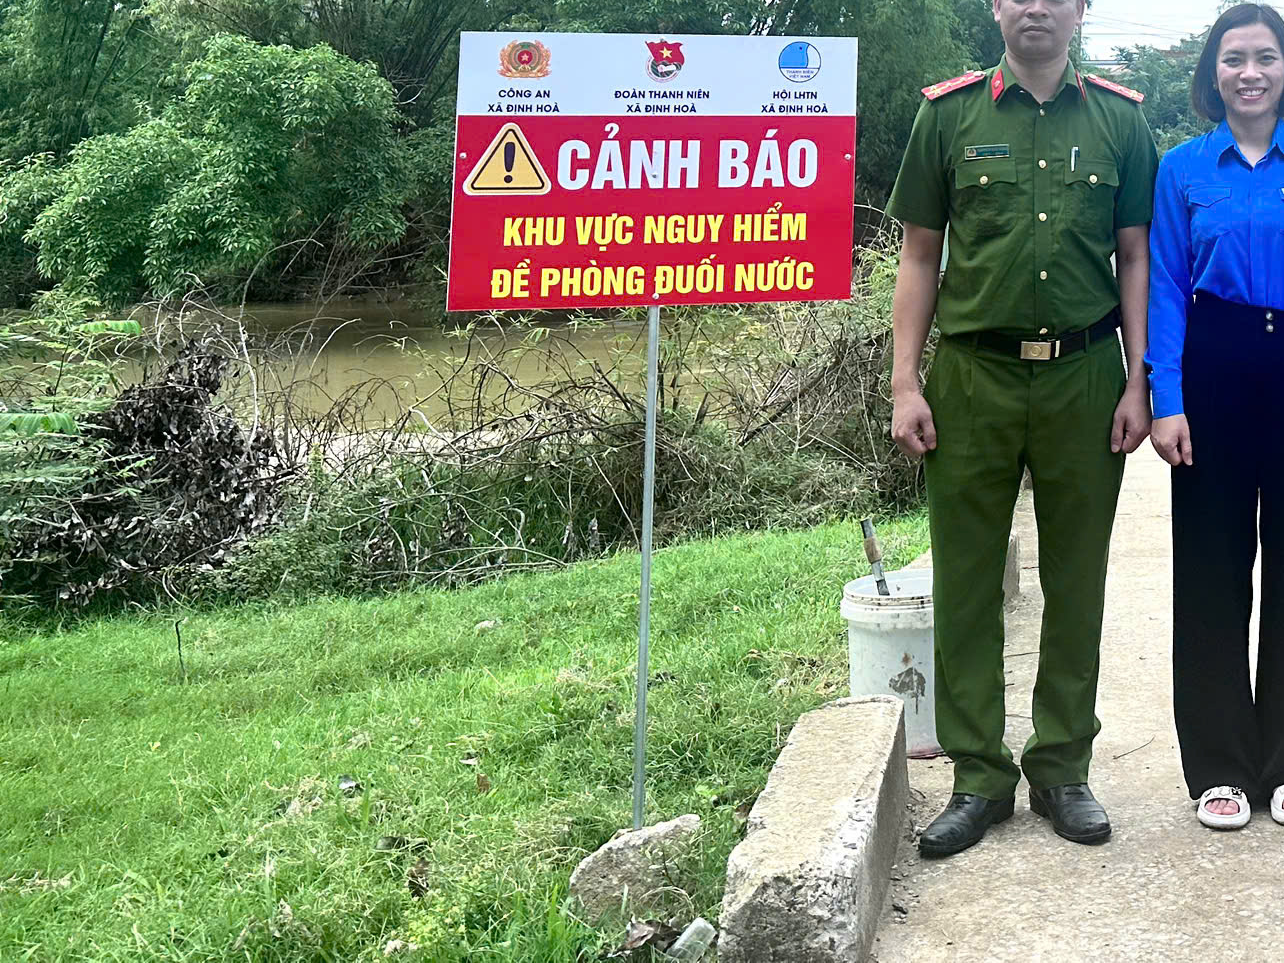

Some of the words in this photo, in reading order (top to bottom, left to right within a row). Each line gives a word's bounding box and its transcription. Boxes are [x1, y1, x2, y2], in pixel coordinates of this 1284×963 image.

[498, 87, 532, 98] CÔNG
[534, 90, 551, 98] AN
[614, 88, 646, 99] ĐOÀN
[648, 90, 684, 99] THANH
[686, 88, 710, 99] NIÊN
[772, 89, 791, 101] HỘI
[794, 91, 818, 100] LHTN
[487, 101, 503, 113] XÃ
[506, 104, 533, 114] ĐỊNH
[536, 101, 560, 113] HOÀ
[626, 102, 642, 113] XÃ
[645, 104, 671, 114] ĐỊNH
[673, 102, 697, 113] HOÀ
[761, 102, 776, 113] XÃ
[778, 104, 804, 115] ĐỊNH
[806, 103, 829, 113] HOÀ
[557, 123, 701, 191] CẢNH
[718, 129, 818, 188] BÁO
[503, 217, 566, 247] KHU
[575, 212, 634, 252] VỰC
[643, 214, 725, 244] NGUY
[733, 201, 807, 243] HIỂM
[490, 258, 531, 299] ĐỀ
[540, 259, 645, 298] PHÒNG
[653, 253, 725, 295] ĐUỐI
[734, 255, 815, 293] NƯỚC
